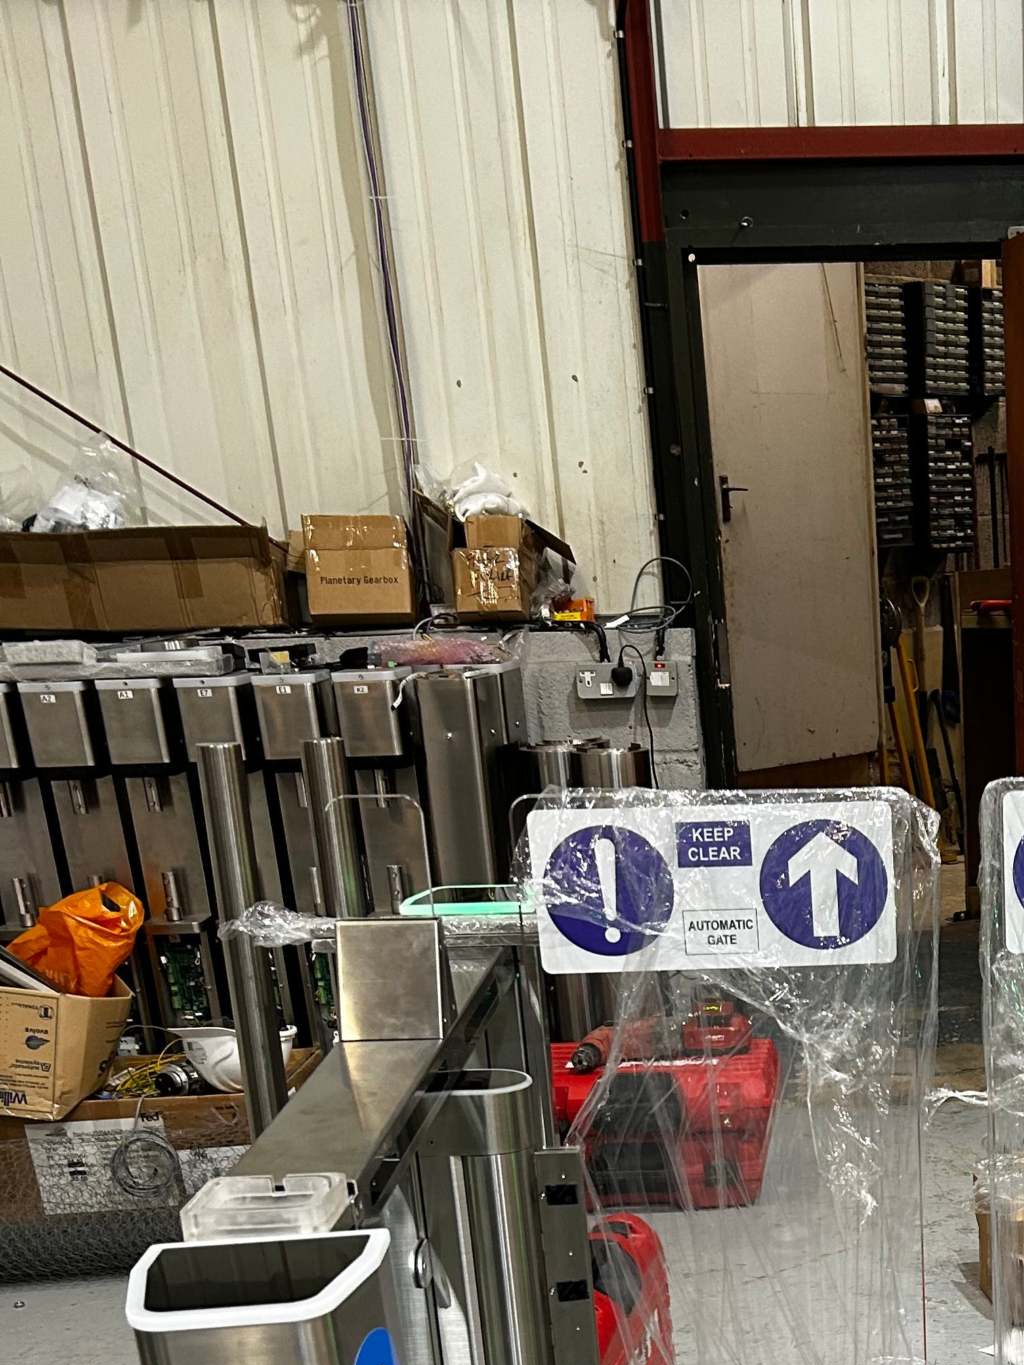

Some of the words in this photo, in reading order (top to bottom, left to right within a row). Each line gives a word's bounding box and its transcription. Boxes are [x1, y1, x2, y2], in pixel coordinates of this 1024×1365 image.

[320, 576, 361, 586] Planetary
[363, 576, 399, 584] Gearbox
[692, 827, 734, 842] KEEP
[688, 847, 741, 861] CLEAR
[688, 919, 754, 932] AUTOMATIC
[707, 934, 737, 945] GATE
